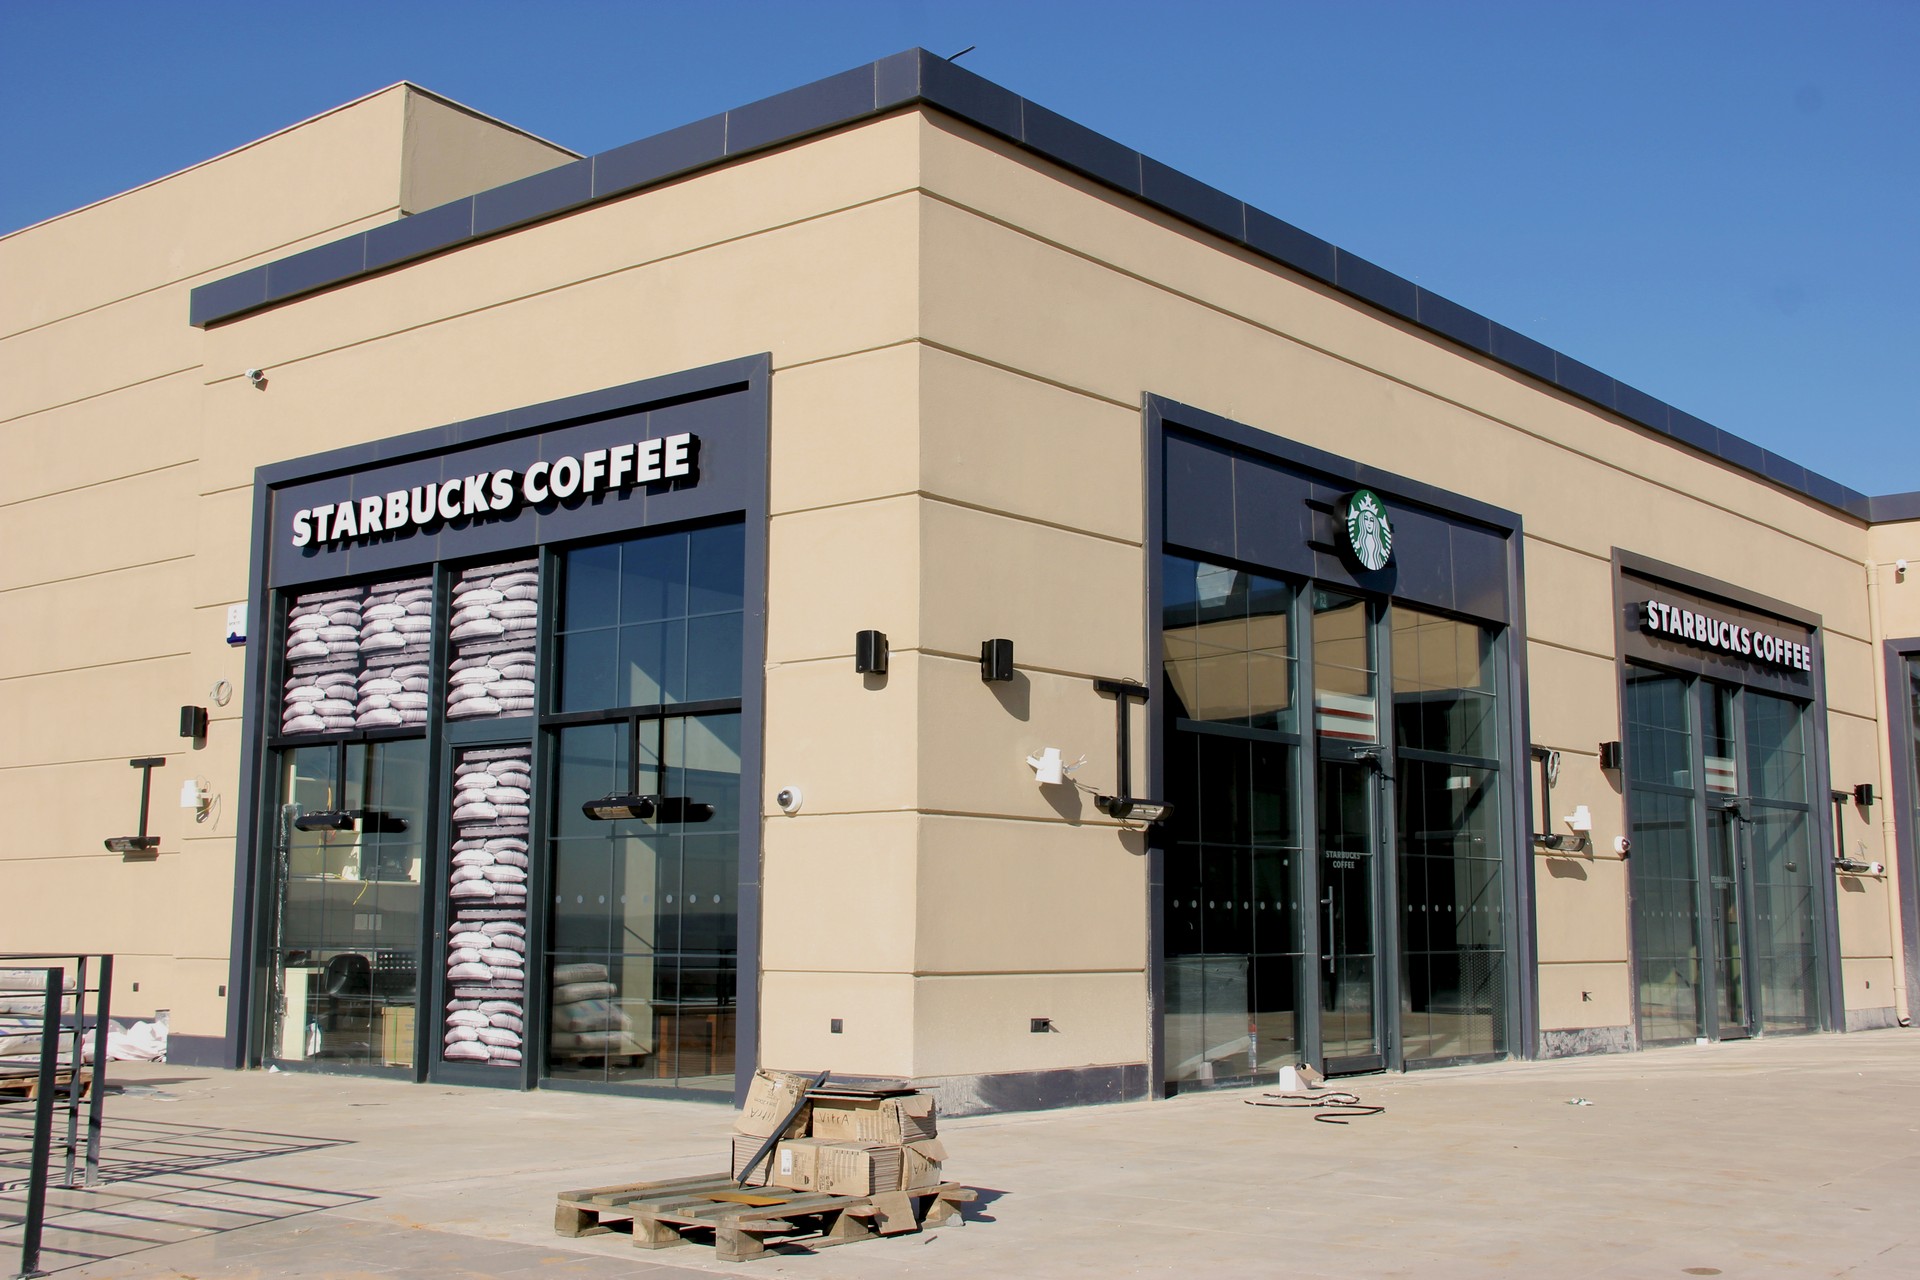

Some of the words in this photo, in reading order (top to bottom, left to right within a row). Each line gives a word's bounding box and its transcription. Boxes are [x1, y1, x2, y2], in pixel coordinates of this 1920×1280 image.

[292, 469, 514, 547] STARBUCKS
[523, 432, 692, 503] COFFEE
[1647, 600, 1750, 655] STARBUCKS
[1753, 632, 1811, 672] COFFEE
[1325, 850, 1361, 860] STARBUCKS
[1332, 860, 1355, 869] COFFEE
